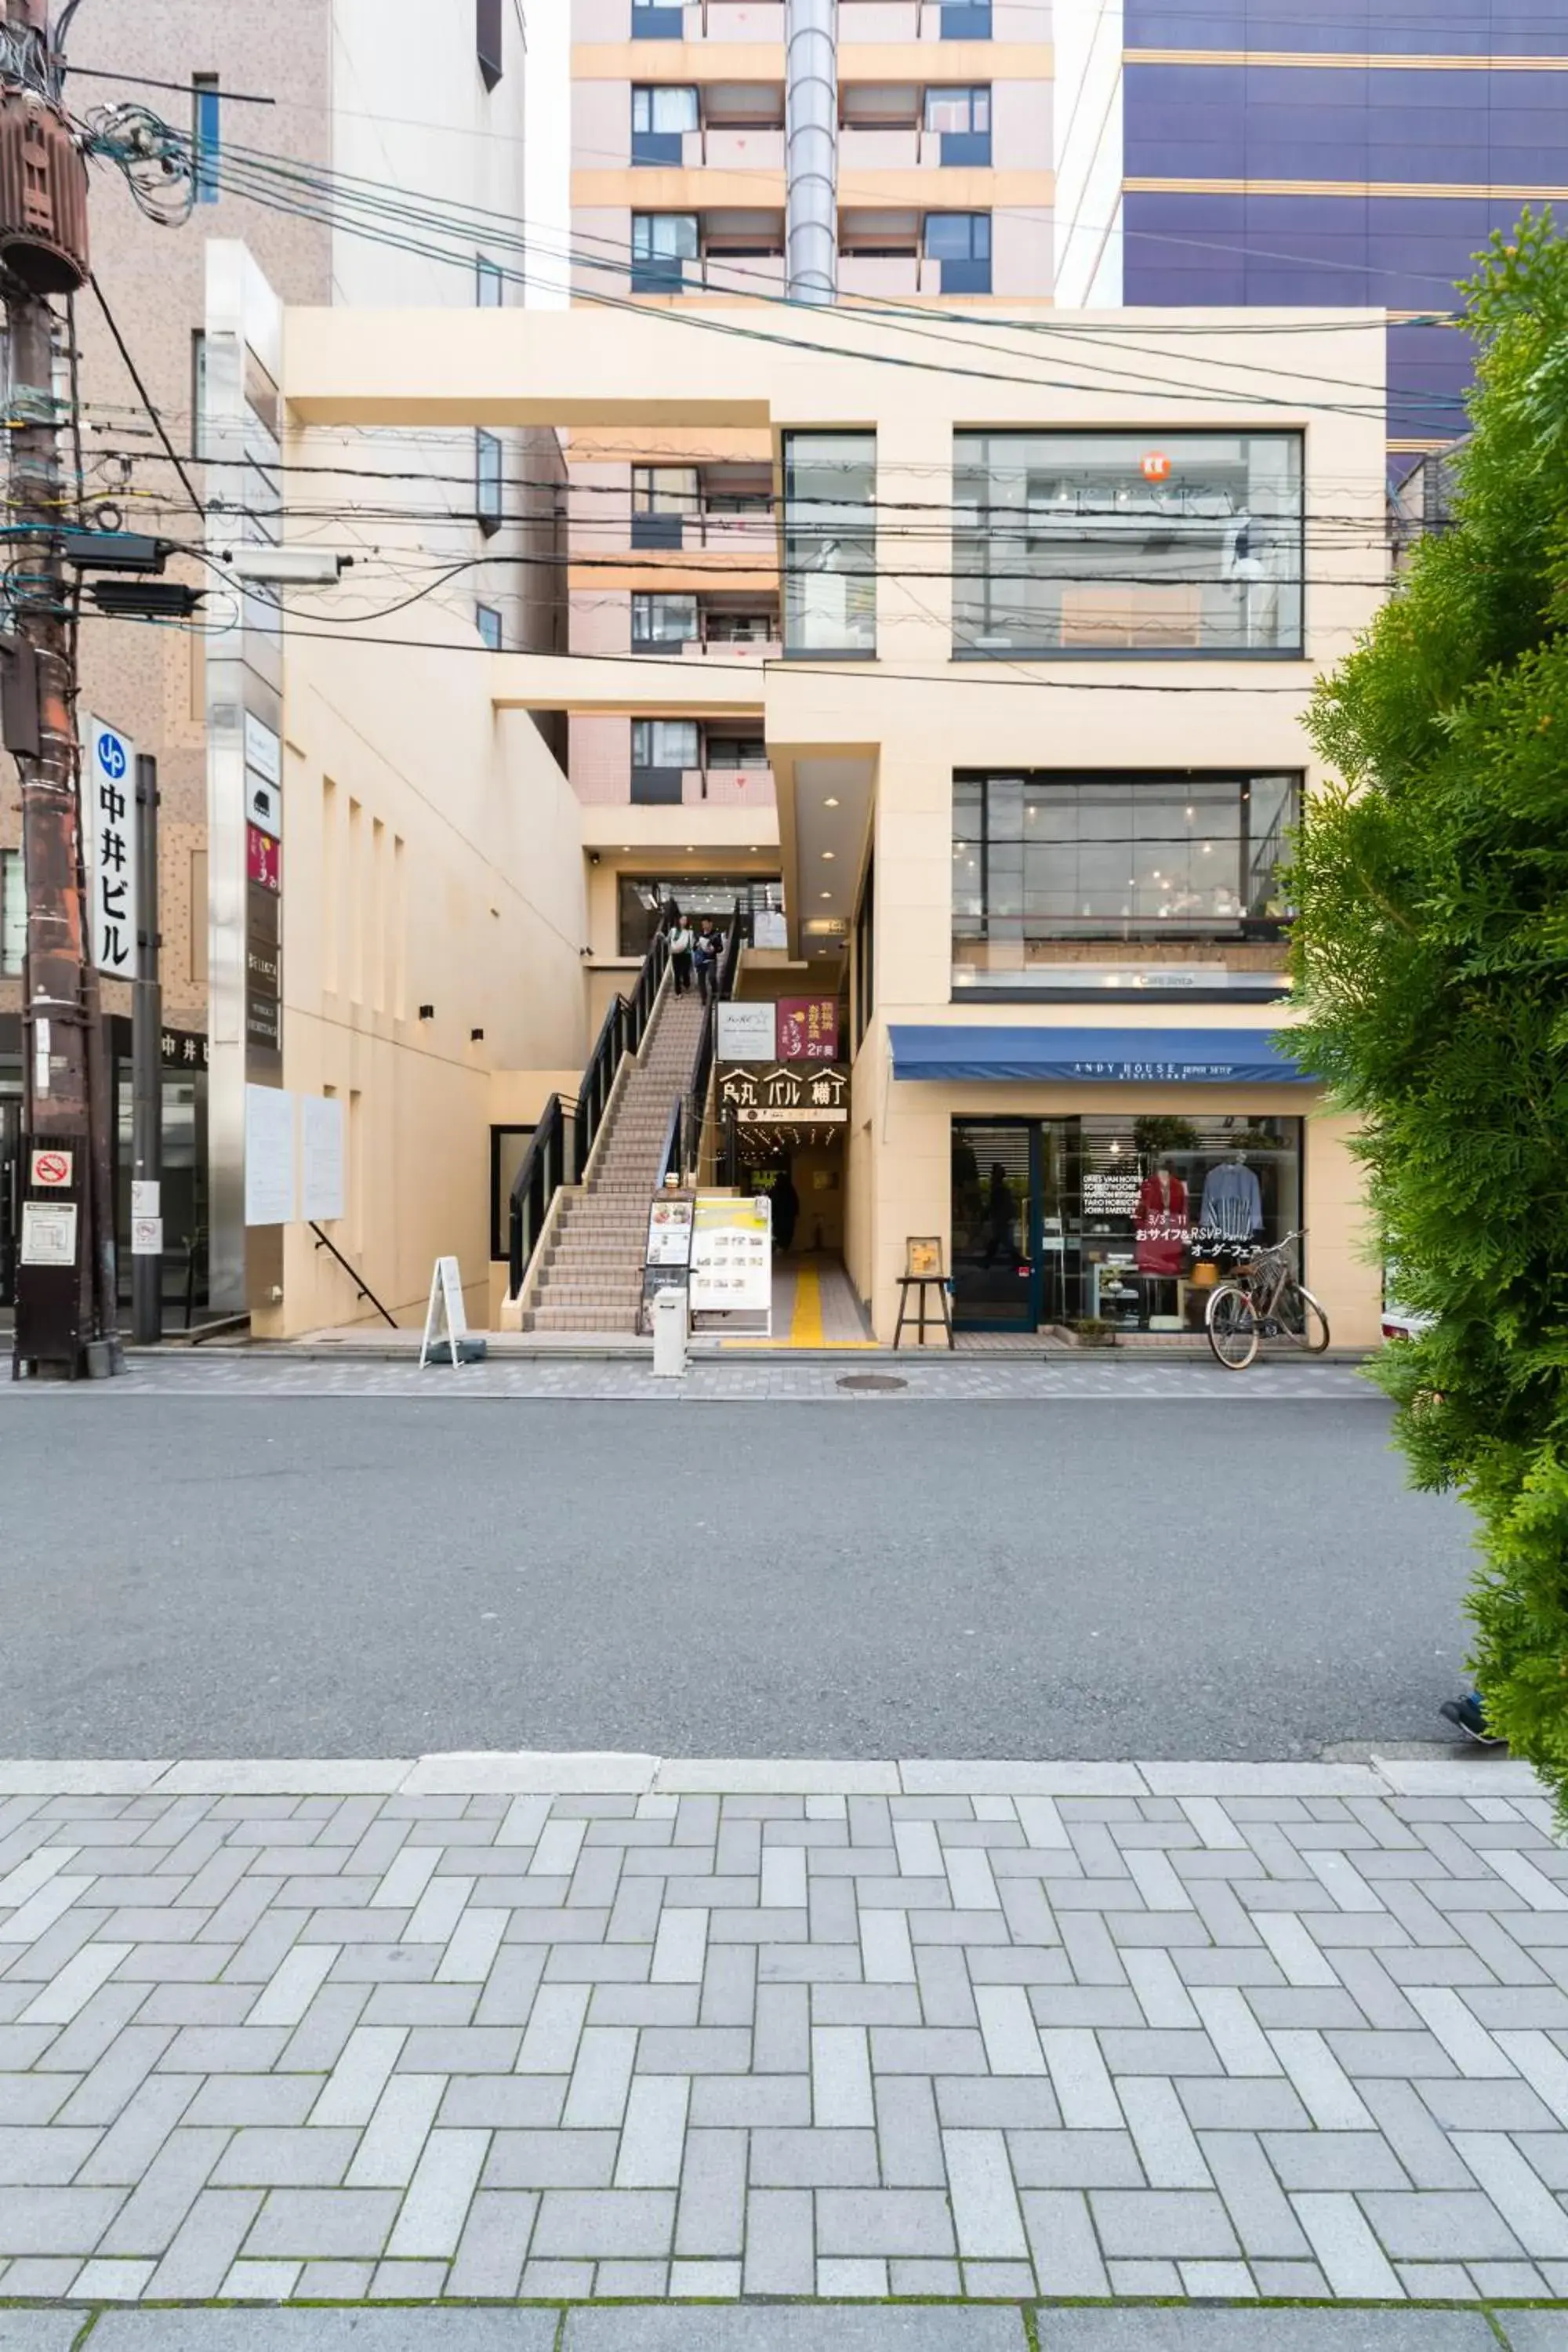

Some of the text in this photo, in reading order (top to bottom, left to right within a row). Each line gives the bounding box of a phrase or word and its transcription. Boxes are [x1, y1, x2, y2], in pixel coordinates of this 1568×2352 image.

[100, 783, 129, 967] 中井ビル
[1074, 1062, 1115, 1073] ANDY
[1123, 1062, 1176, 1073] HOUSE
[812, 1081, 844, 1105] 横丁
[1190, 1227, 1222, 1240] RSVP
